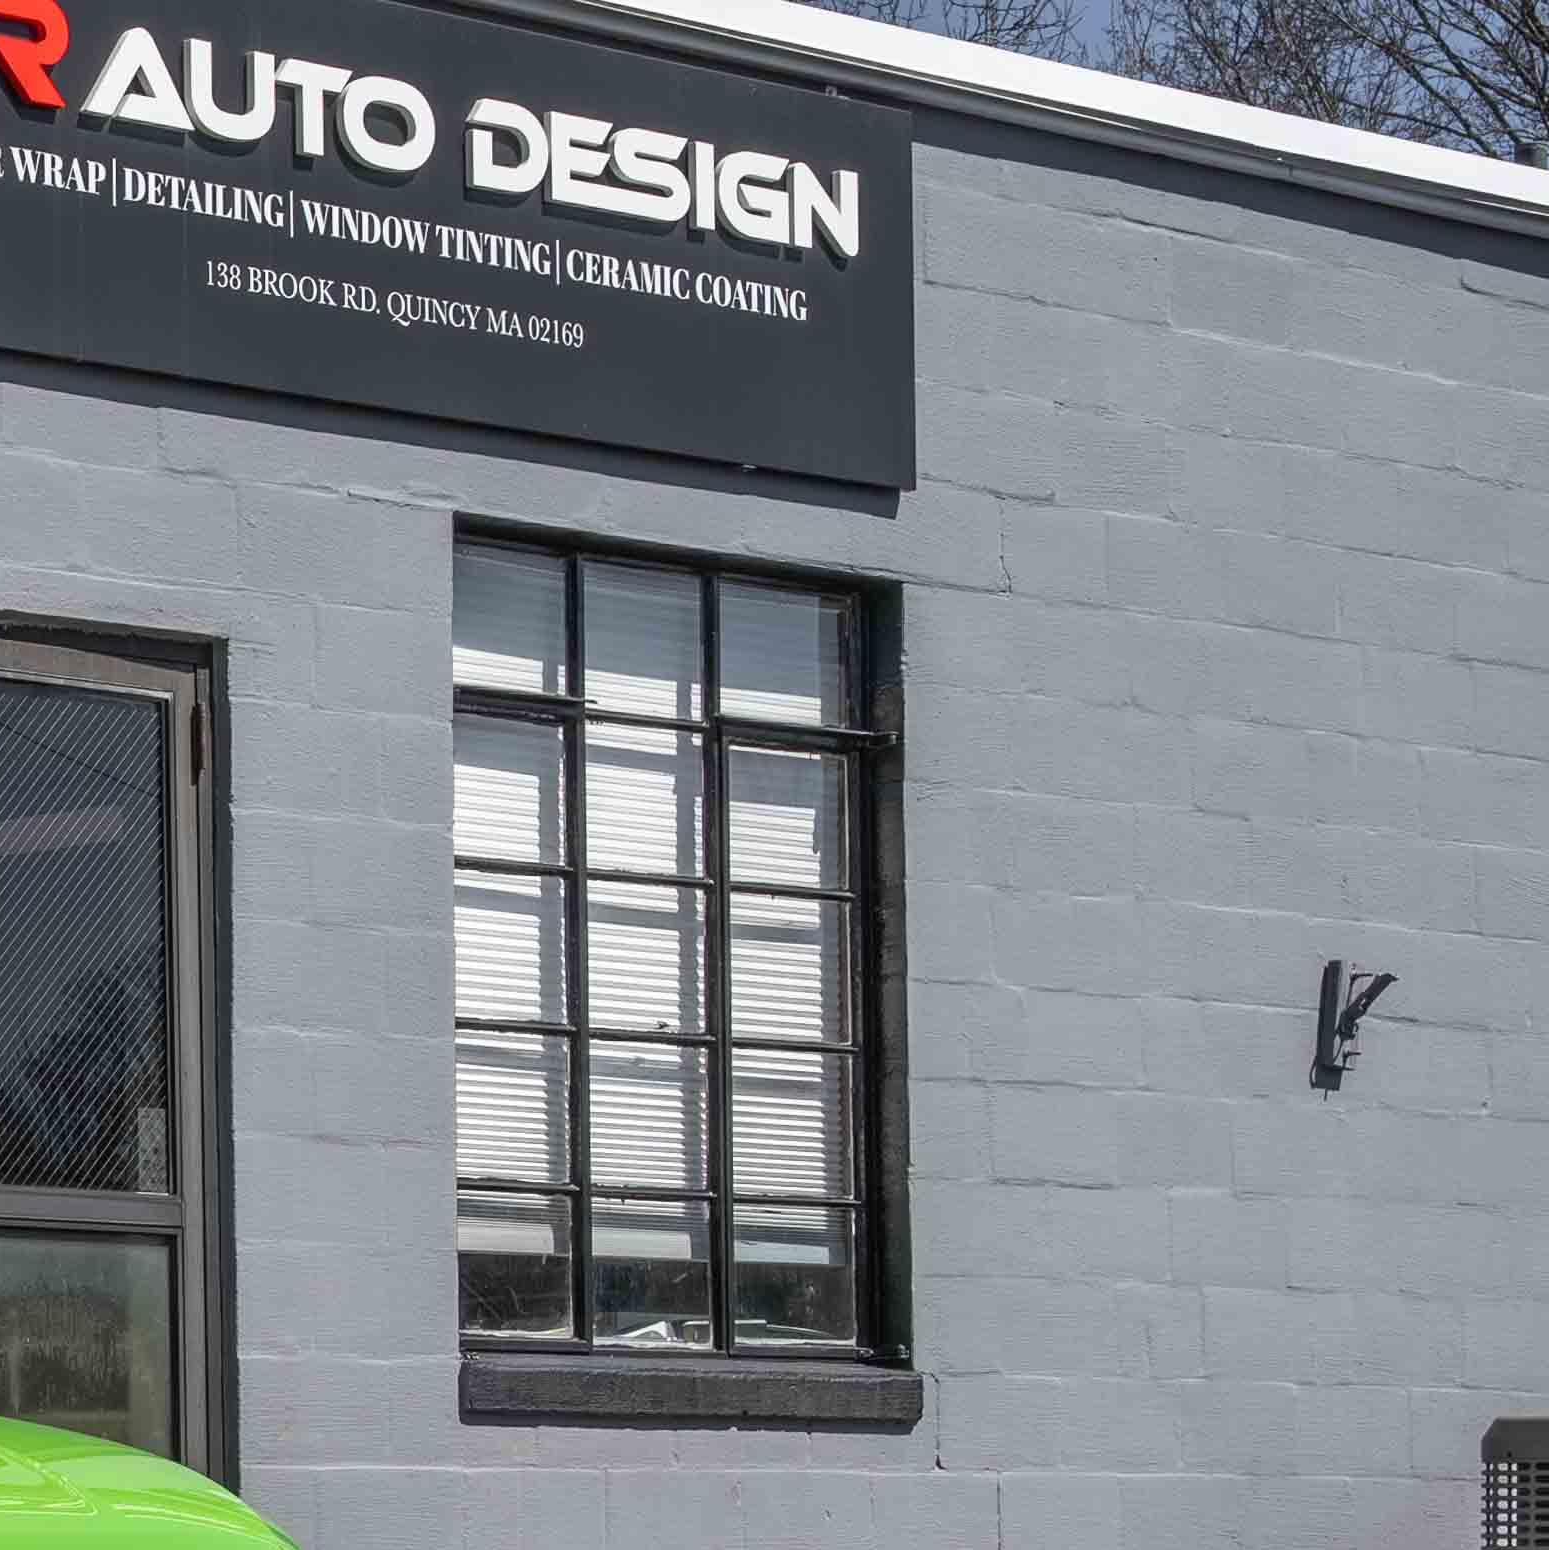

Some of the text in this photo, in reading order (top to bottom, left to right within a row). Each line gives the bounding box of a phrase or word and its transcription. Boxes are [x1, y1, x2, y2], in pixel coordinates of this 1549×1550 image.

[79, 26, 436, 173] AUTO
[465, 98, 859, 258] DESIGN
[9, 145, 107, 196] WRAP
[122, 166, 285, 229] DETAILING
[301, 199, 429, 254] WINDOW
[434, 223, 552, 276] TINTING
[565, 248, 691, 300] CERAMIC
[694, 271, 808, 321] COATING
[205, 260, 585, 349] 138 BROOK RD. QUINCY MA 02169
